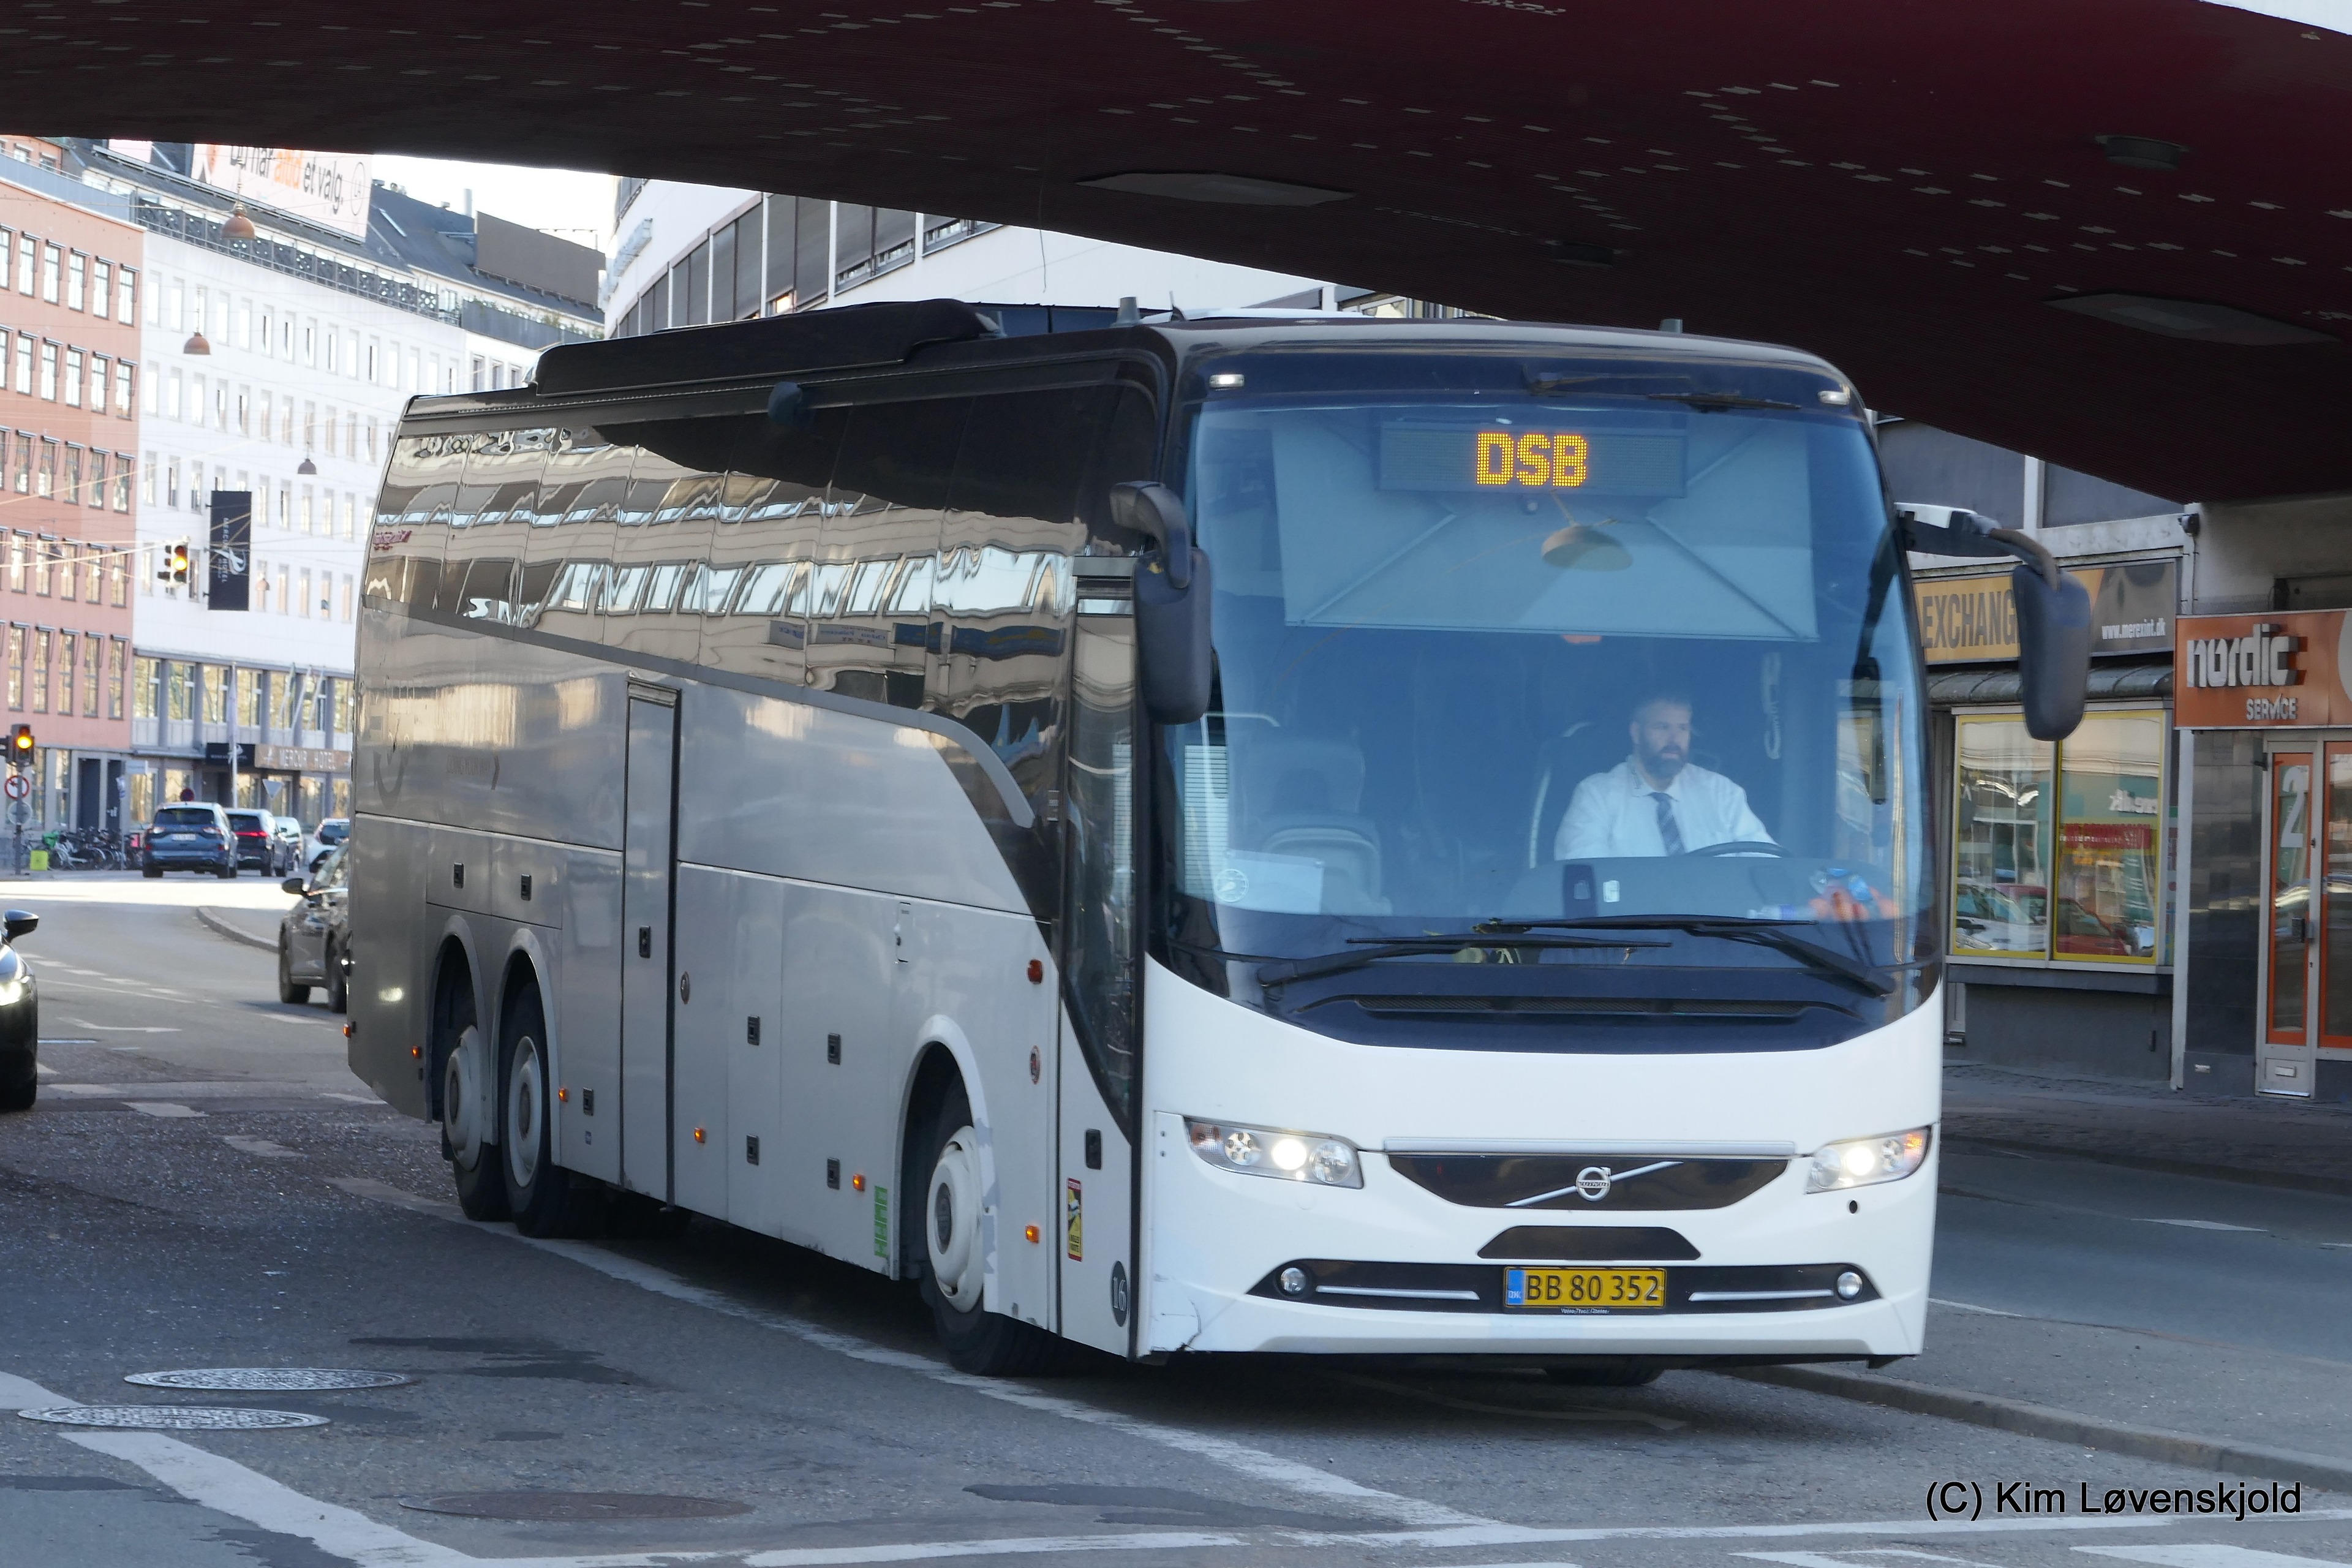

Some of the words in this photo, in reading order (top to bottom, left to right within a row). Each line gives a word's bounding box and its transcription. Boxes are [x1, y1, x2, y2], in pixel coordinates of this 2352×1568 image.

[1476, 432, 1588, 487] DSB
[1922, 589, 2018, 649] EXCHANG
[2187, 624, 2291, 687] nordic
[2246, 693, 2297, 720] SERVICE
[279, 748, 308, 768] MERCUR
[314, 751, 336, 770] HOTEL
[2280, 766, 2305, 848] 2
[1114, 1276, 1126, 1311] 16
[1508, 1289, 1521, 1299] DK
[1527, 1275, 1561, 1300] BB
[1570, 1275, 1602, 1301] 80
[1610, 1275, 1659, 1302] 352
